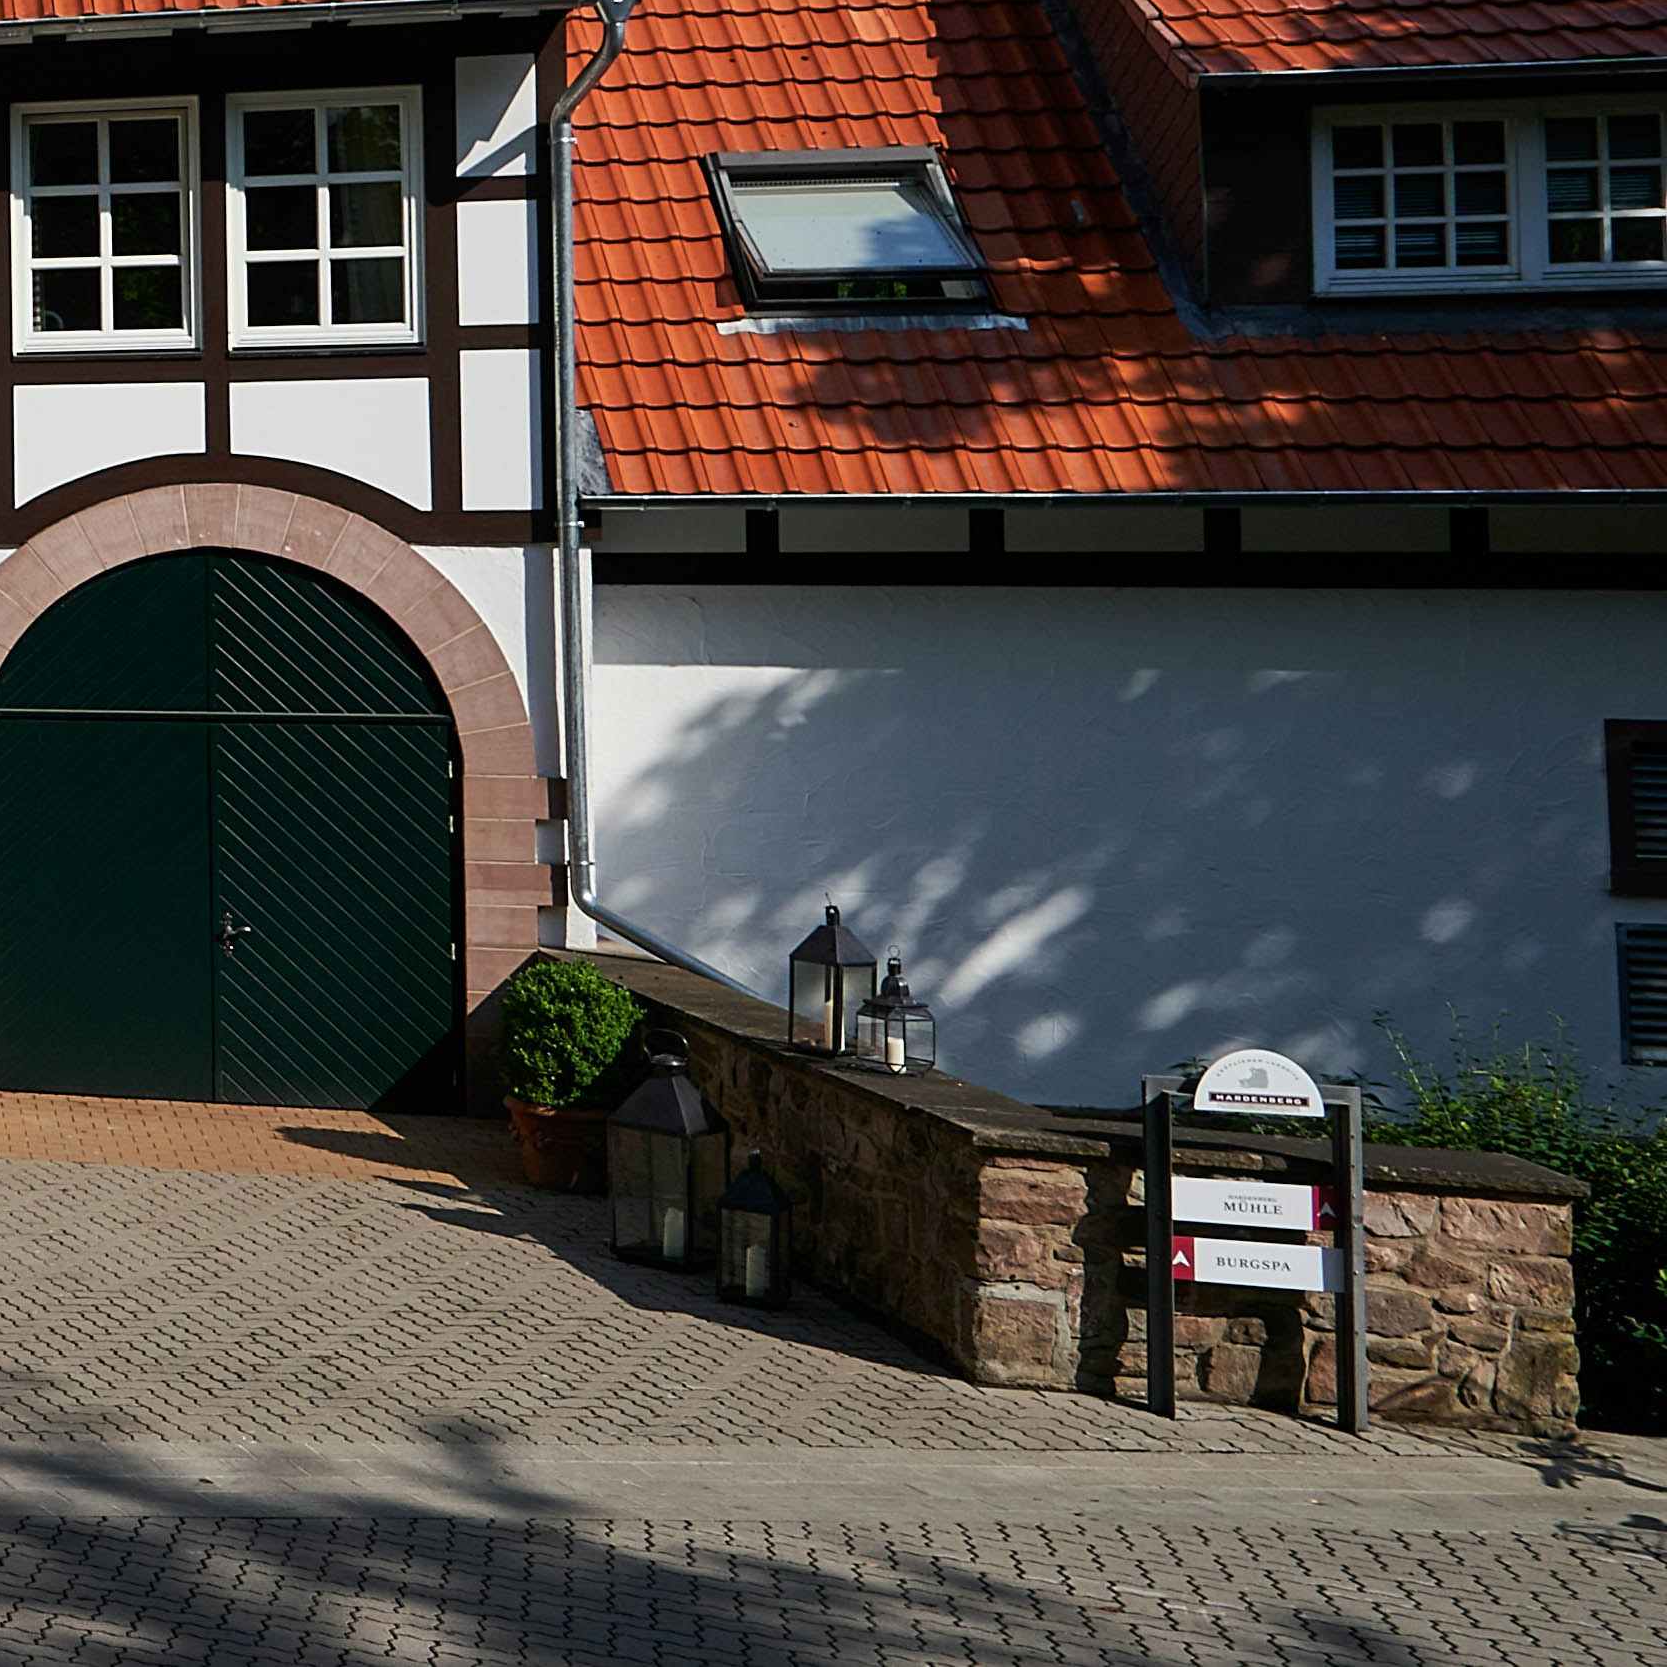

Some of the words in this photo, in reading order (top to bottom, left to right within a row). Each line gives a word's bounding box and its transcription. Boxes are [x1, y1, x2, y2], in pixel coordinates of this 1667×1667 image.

[1215, 1094, 1302, 1105] HARDENBERG
[1223, 1200, 1284, 1215] MÜHLE
[1216, 1256, 1292, 1272] BURGSPA
